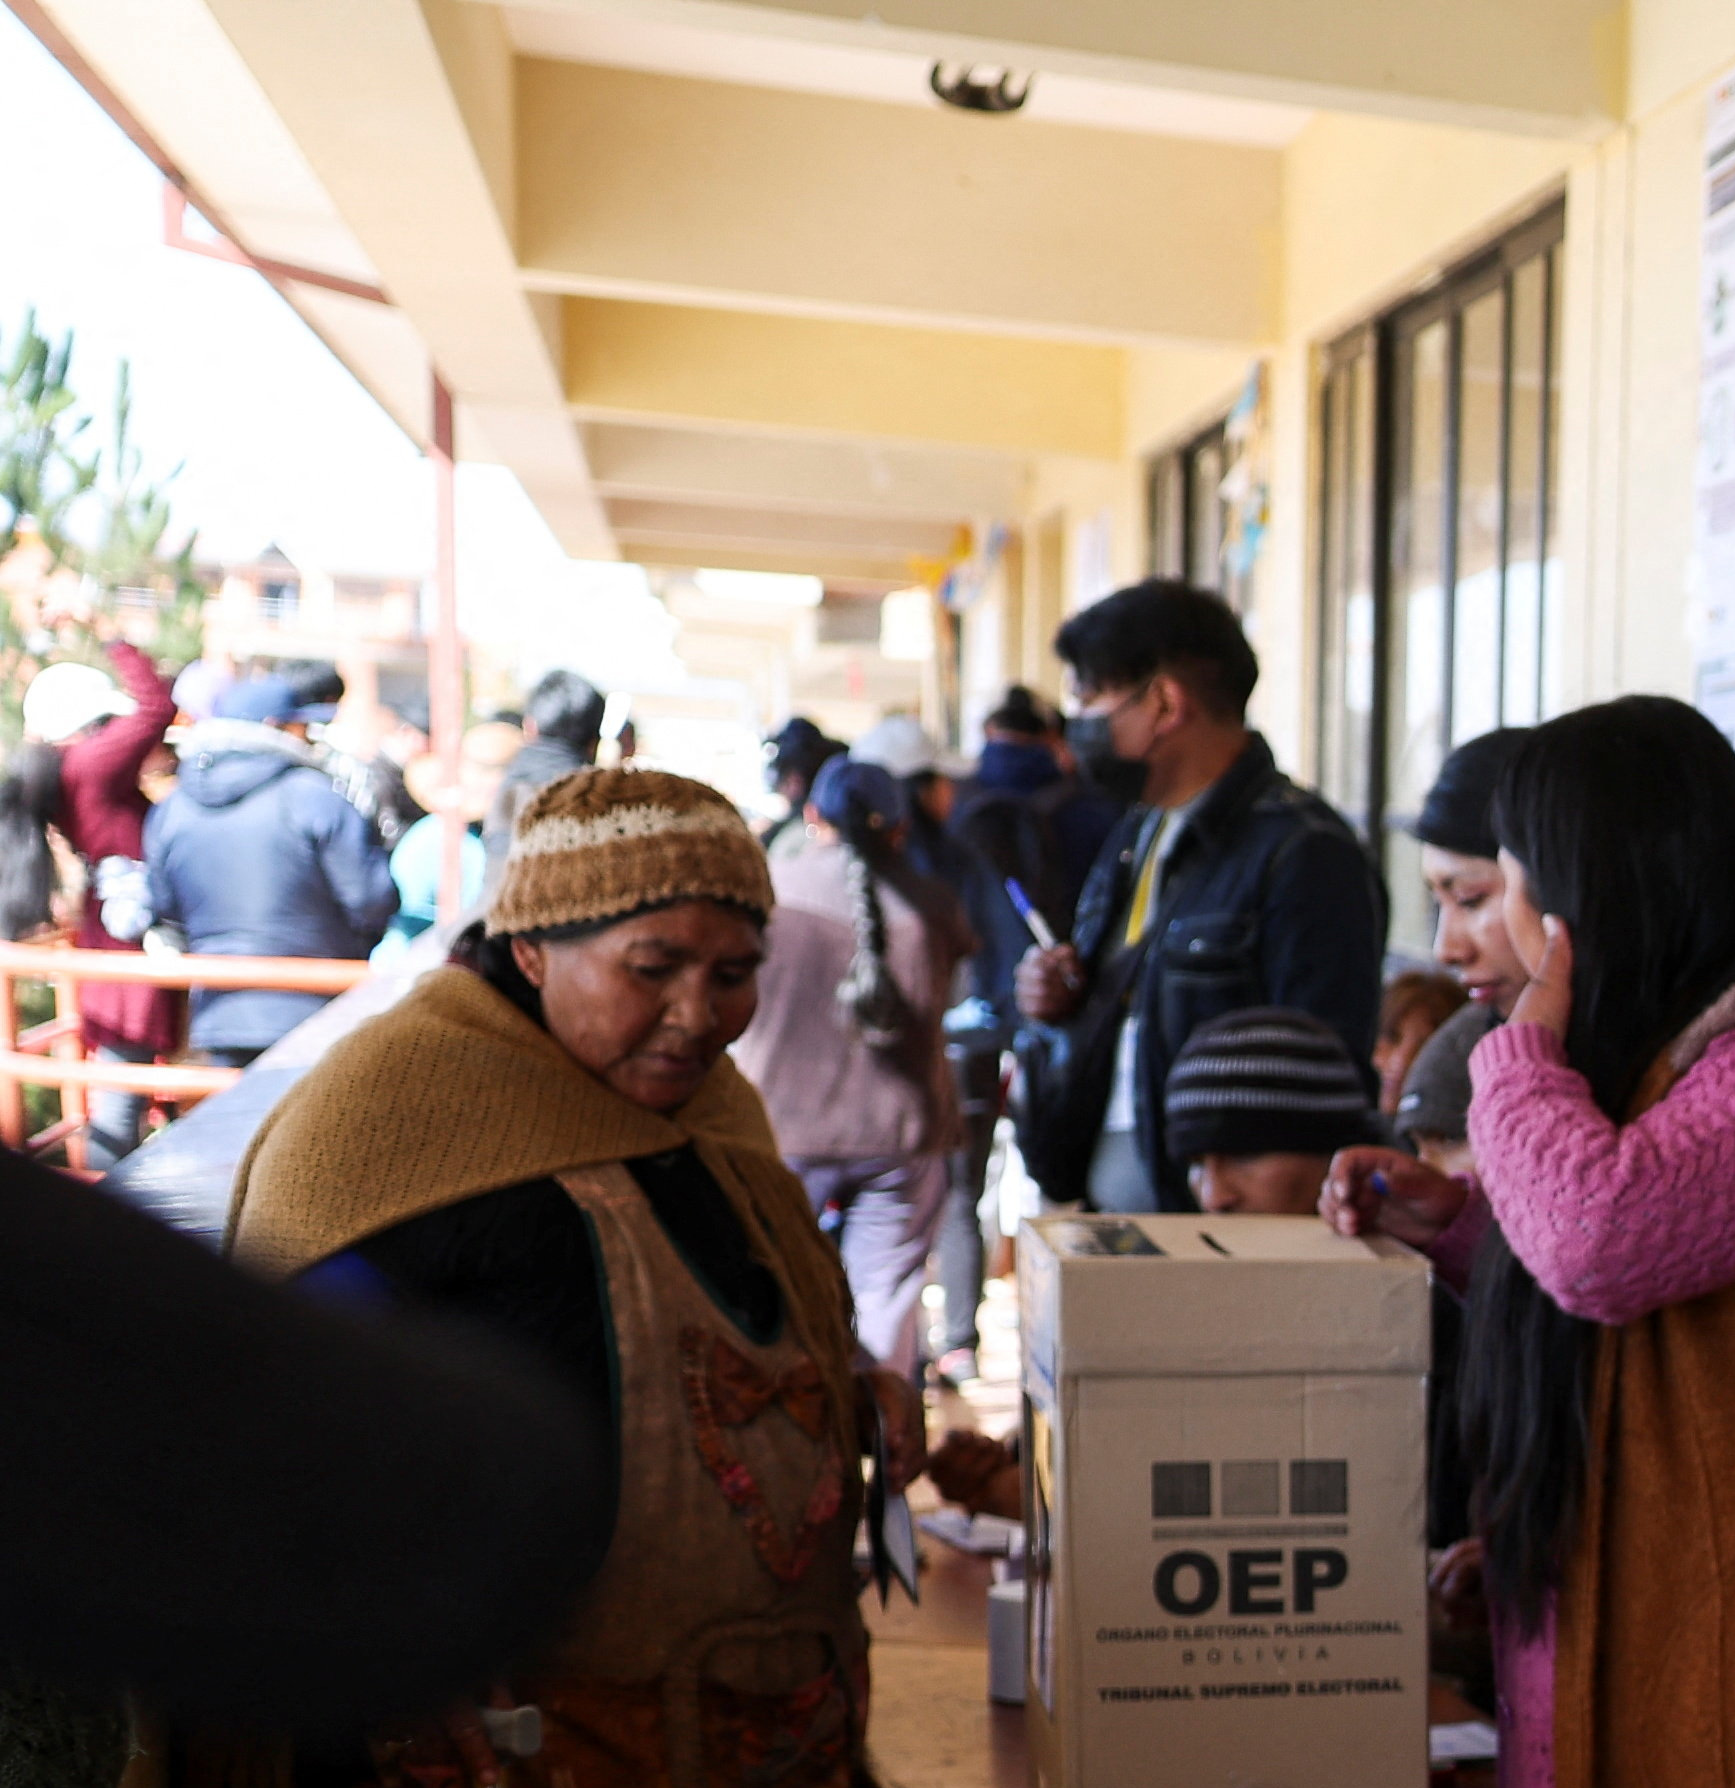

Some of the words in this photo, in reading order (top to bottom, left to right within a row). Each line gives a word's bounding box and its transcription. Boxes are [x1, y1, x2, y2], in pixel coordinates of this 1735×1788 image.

[1153, 1547, 1348, 1618] OEP
[1173, 1624, 1268, 1640] ELECTORAL
[1274, 1620, 1402, 1638] PLURINACIONAL
[1097, 1684, 1194, 1702] TRIBUNAL
[1200, 1681, 1291, 1698] SUPREMO
[1296, 1677, 1402, 1695] ELECTORAL
